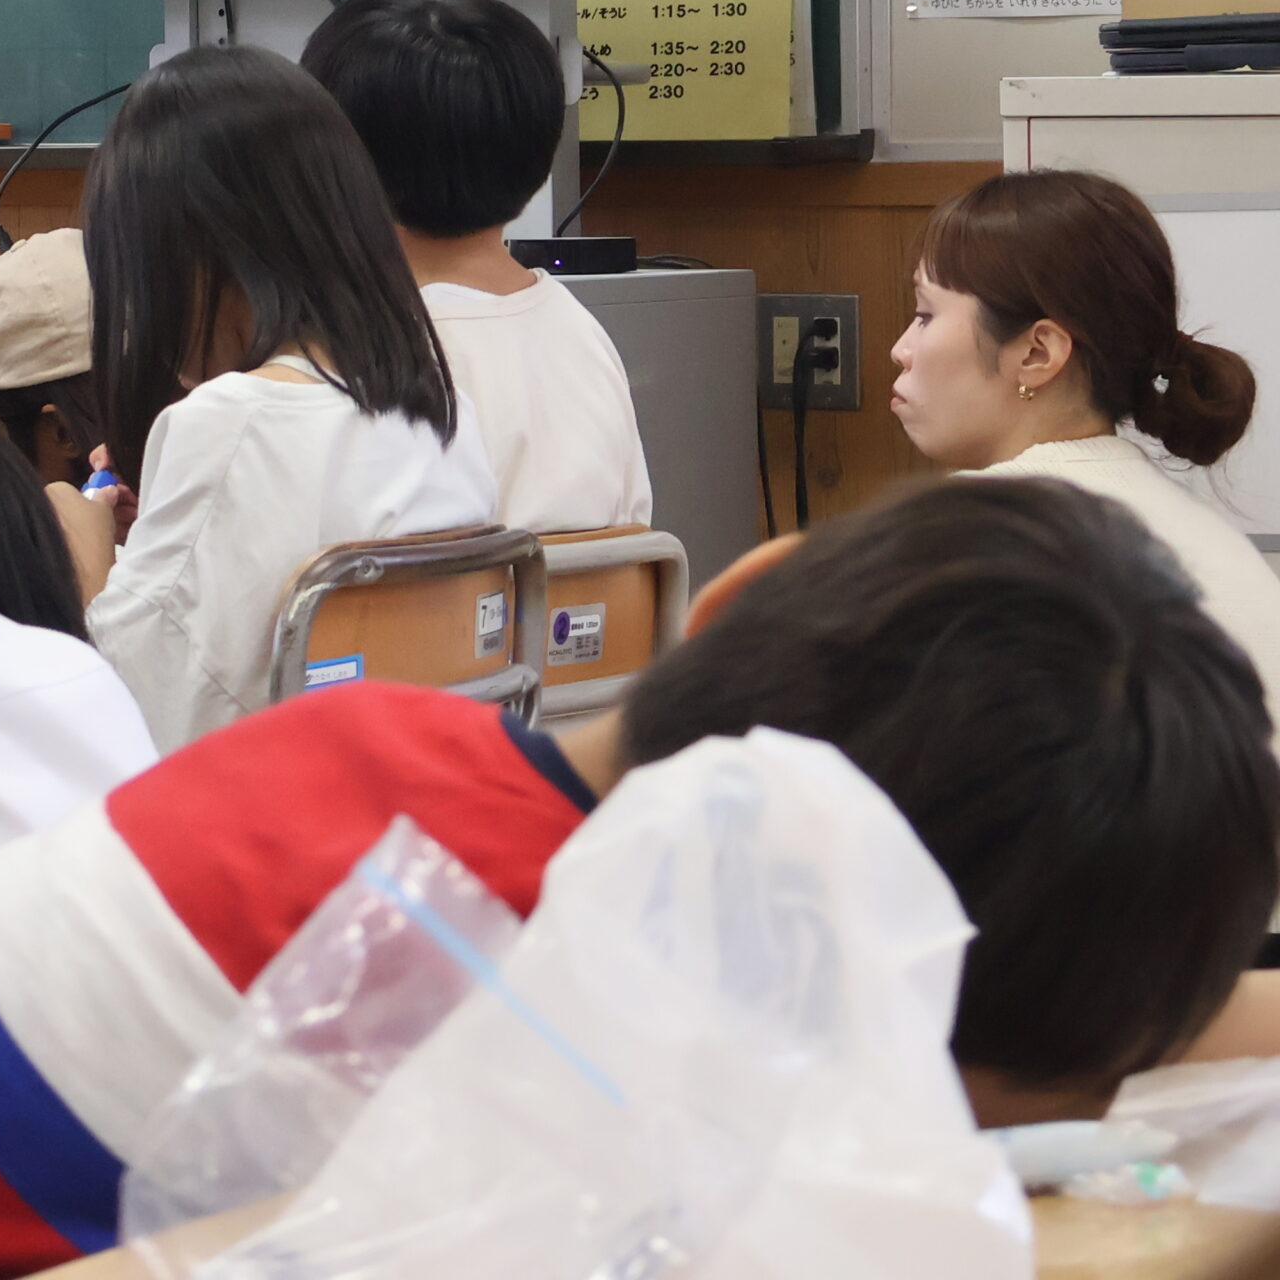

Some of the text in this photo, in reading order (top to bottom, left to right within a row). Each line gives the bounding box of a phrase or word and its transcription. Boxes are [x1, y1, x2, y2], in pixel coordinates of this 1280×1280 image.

[577, 7, 627, 20] ル/そうじ
[712, 2, 747, 17] 1:30
[583, 43, 612, 57] んめ
[709, 40, 746, 54] 2:20
[709, 61, 745, 76] 2:30
[648, 84, 684, 99] 2:30
